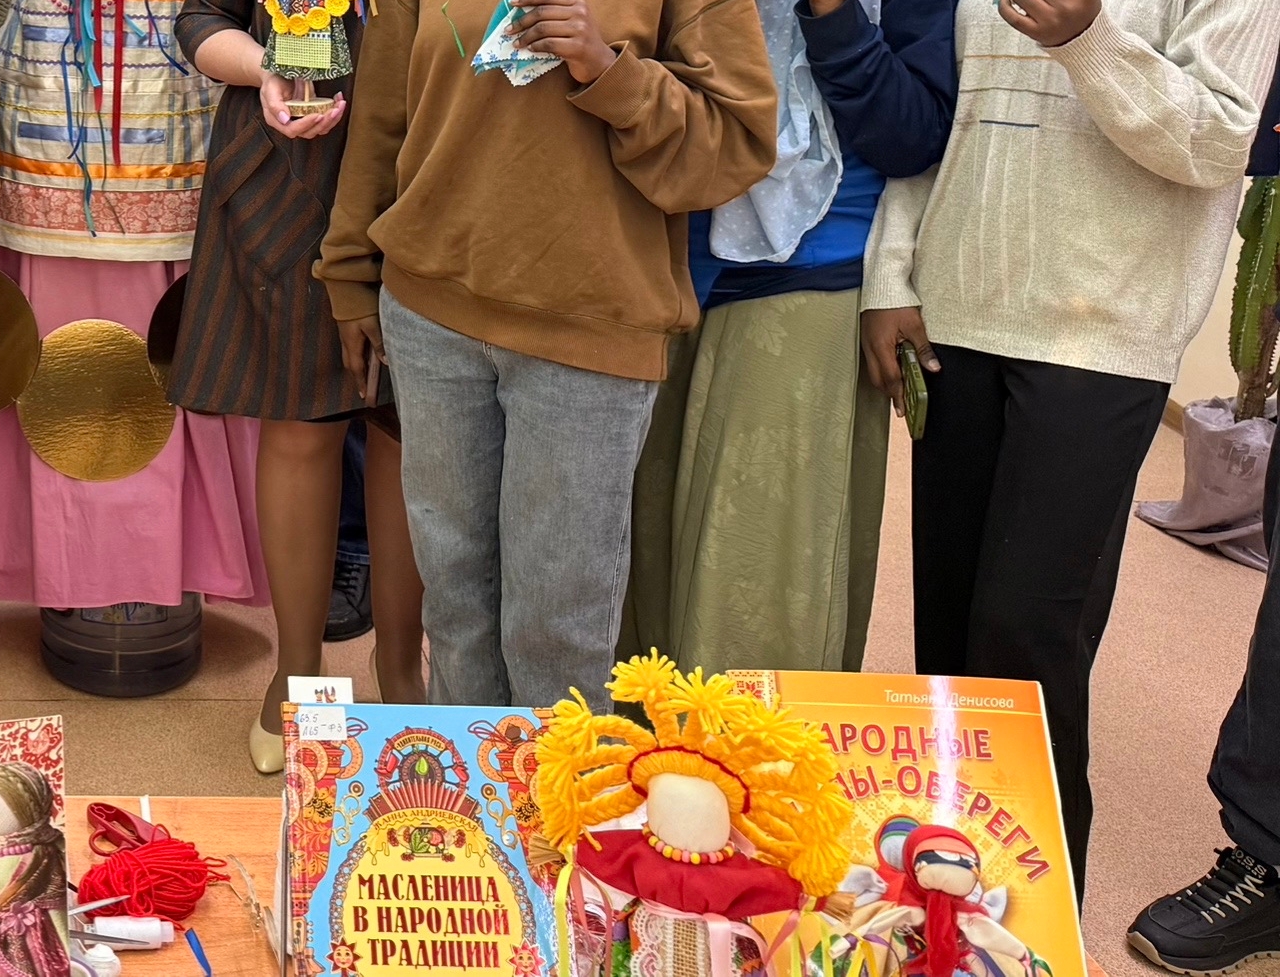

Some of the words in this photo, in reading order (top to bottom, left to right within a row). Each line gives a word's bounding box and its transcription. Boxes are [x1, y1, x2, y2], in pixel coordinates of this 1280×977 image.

[884, 689, 942, 706] Татьян
[950, 692, 1014, 708] Денисова
[804, 722, 993, 762] АРОДНЫЕ
[374, 810, 408, 830] ЖАННА
[409, 809, 479, 832] АНДРИЕВСКАЯ
[357, 873, 501, 905] МАСЛЕНИЦА
[352, 906, 369, 932] В
[376, 904, 511, 937] НАРОДНОЙ
[367, 938, 501, 971] ТРАДИЦИИ
